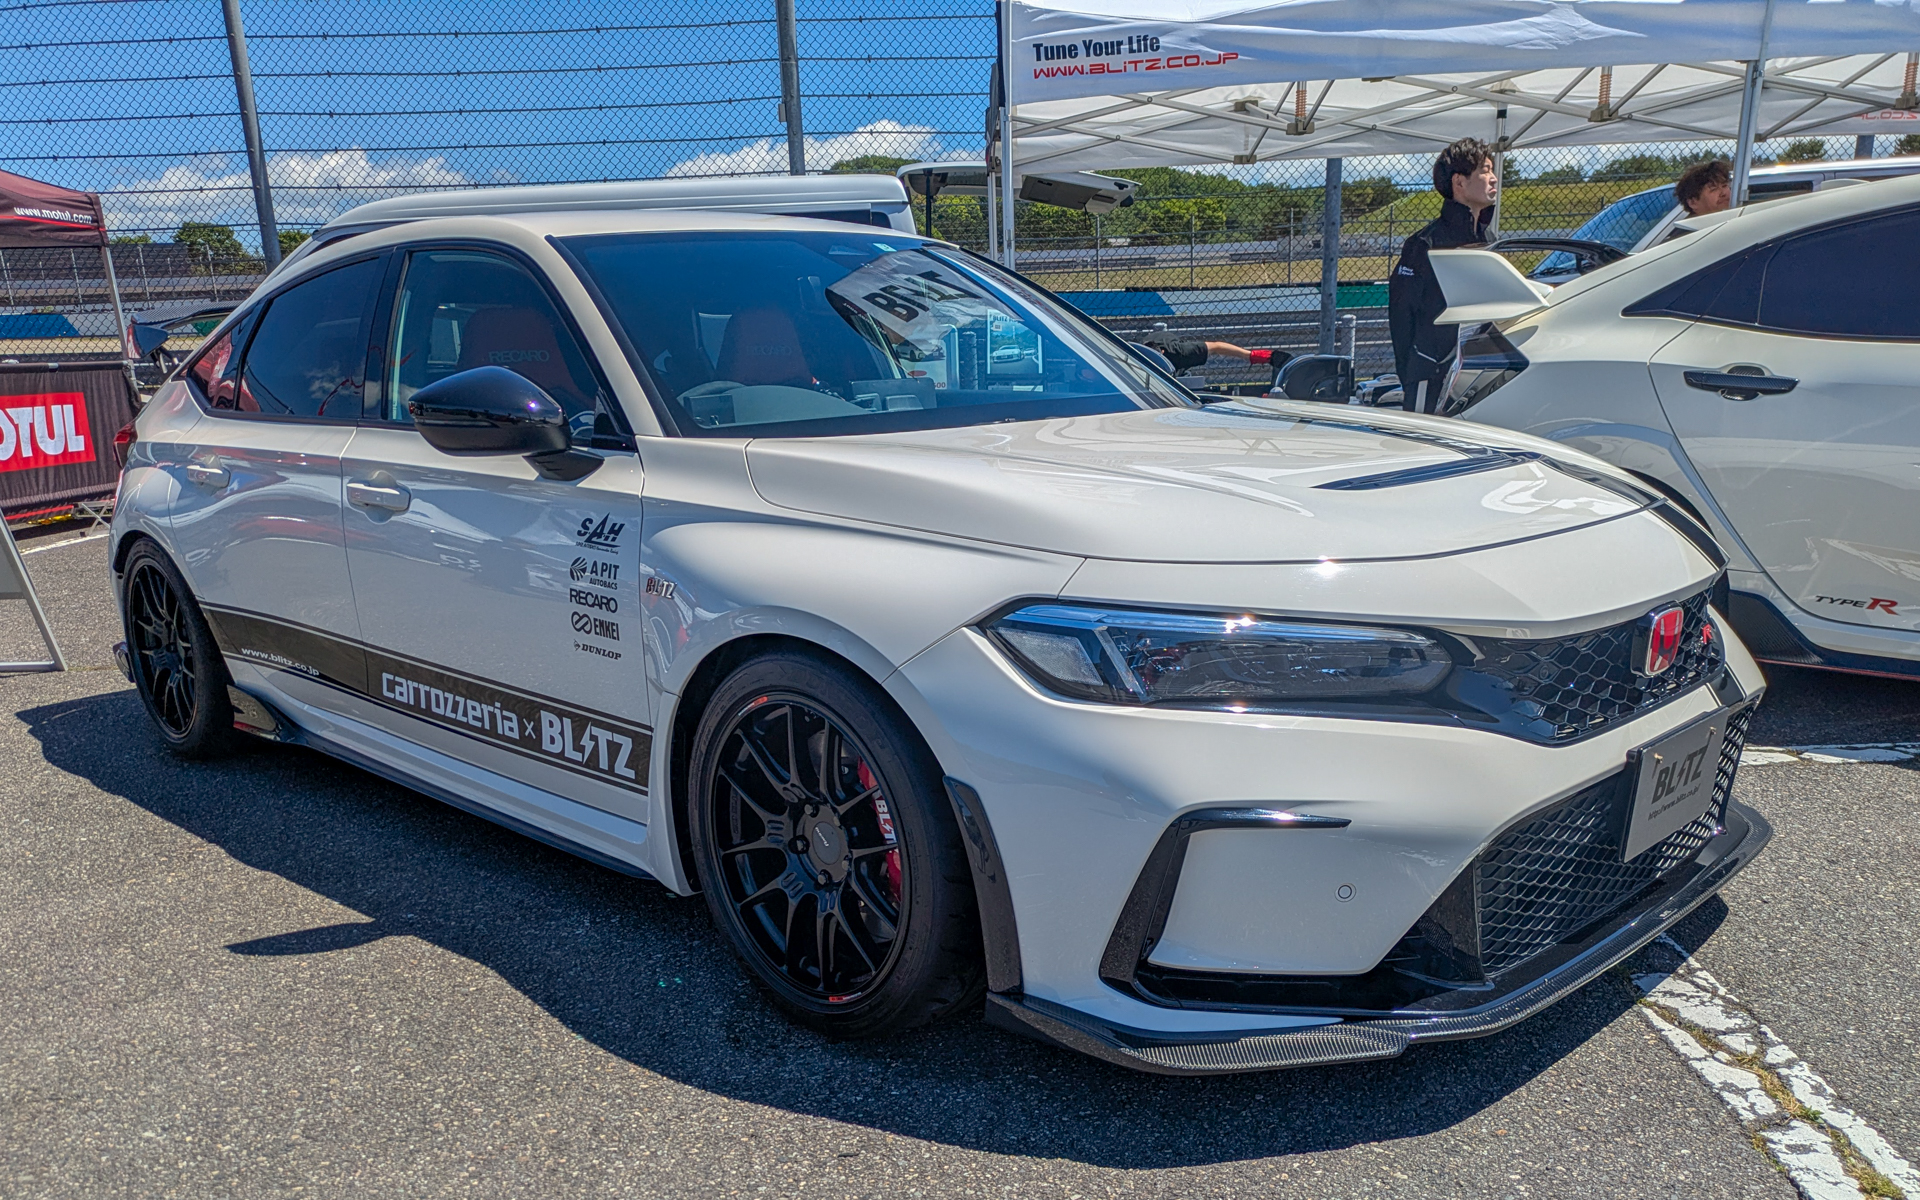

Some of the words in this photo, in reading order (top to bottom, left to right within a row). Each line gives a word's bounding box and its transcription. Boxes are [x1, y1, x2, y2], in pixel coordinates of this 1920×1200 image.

[1033, 42, 1079, 62] Tune
[1082, 38, 1124, 58] Your
[1127, 34, 1161, 54] Life
[13, 206, 92, 224] www.motul.com
[488, 349, 550, 363] RECARO
[600, 561, 620, 581] PIT
[589, 577, 618, 590] AUTOBACS
[645, 576, 678, 600] BLITZ
[569, 587, 618, 614] RECARO
[1816, 595, 1867, 608] TYPE
[1865, 597, 1901, 616] R
[593, 617, 620, 641] ENKEI
[241, 648, 320, 676] www.blitz.co.jp
[581, 643, 622, 661] DUNLOP
[382, 672, 520, 740] carrozzeria
[540, 710, 636, 780] BLITZ
[1651, 744, 1709, 805] BLITZ
